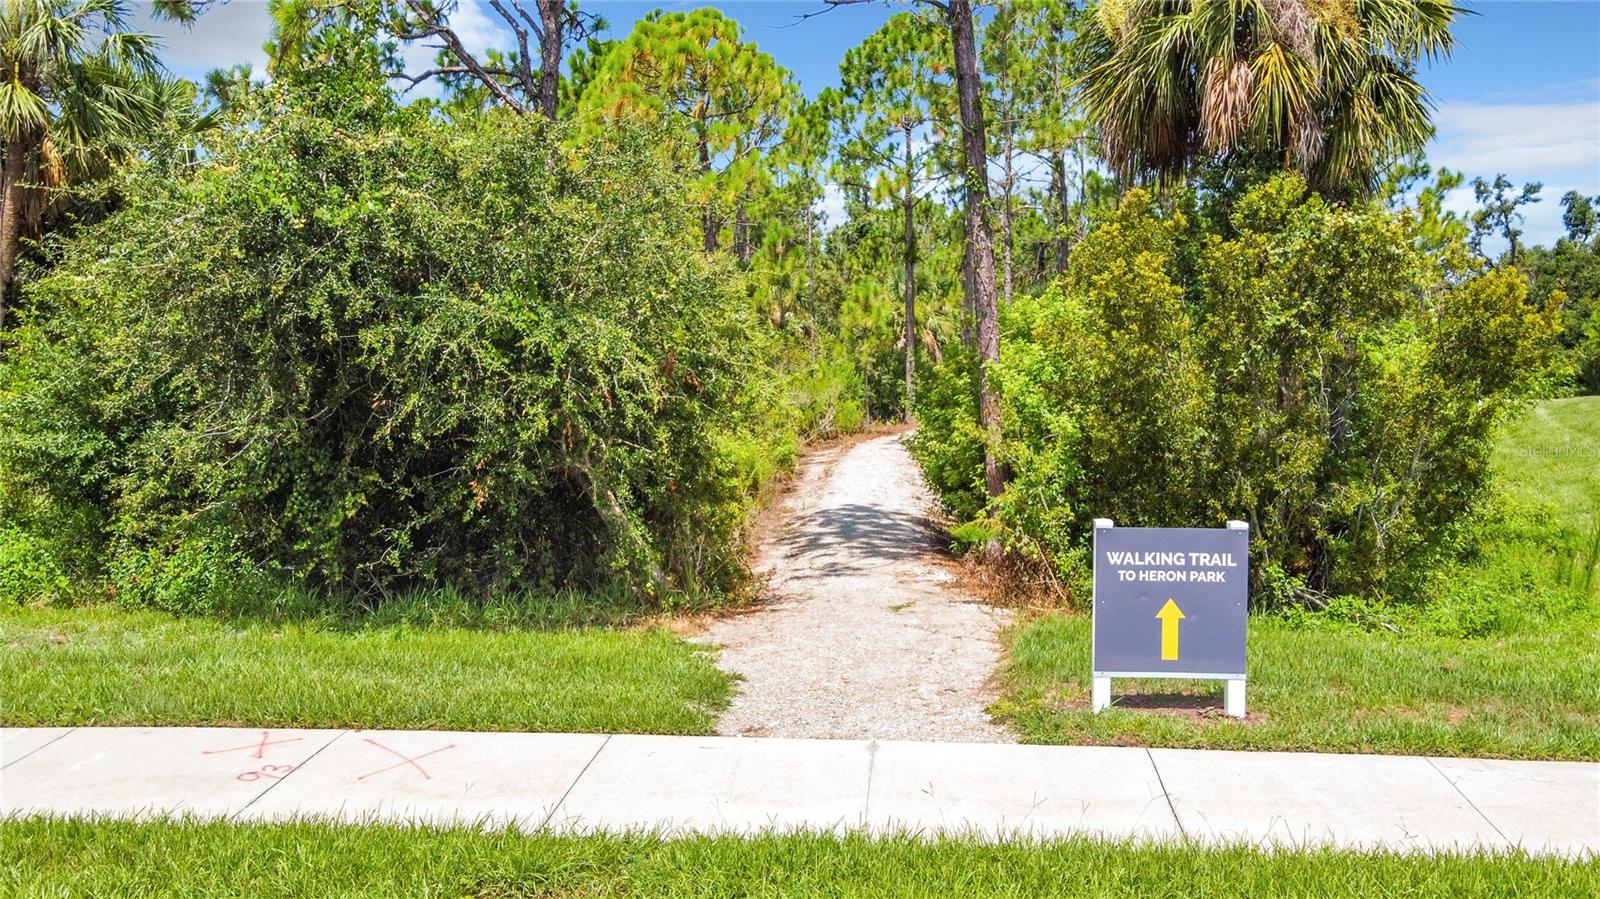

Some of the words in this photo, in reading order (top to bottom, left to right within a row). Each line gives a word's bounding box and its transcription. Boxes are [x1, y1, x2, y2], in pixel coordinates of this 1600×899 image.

[1106, 551, 1186, 566] WALKING
[1188, 552, 1238, 567] TRAIL
[1117, 570, 1136, 582] TO
[1139, 570, 1187, 582] HERON
[1189, 571, 1226, 583] PARK
